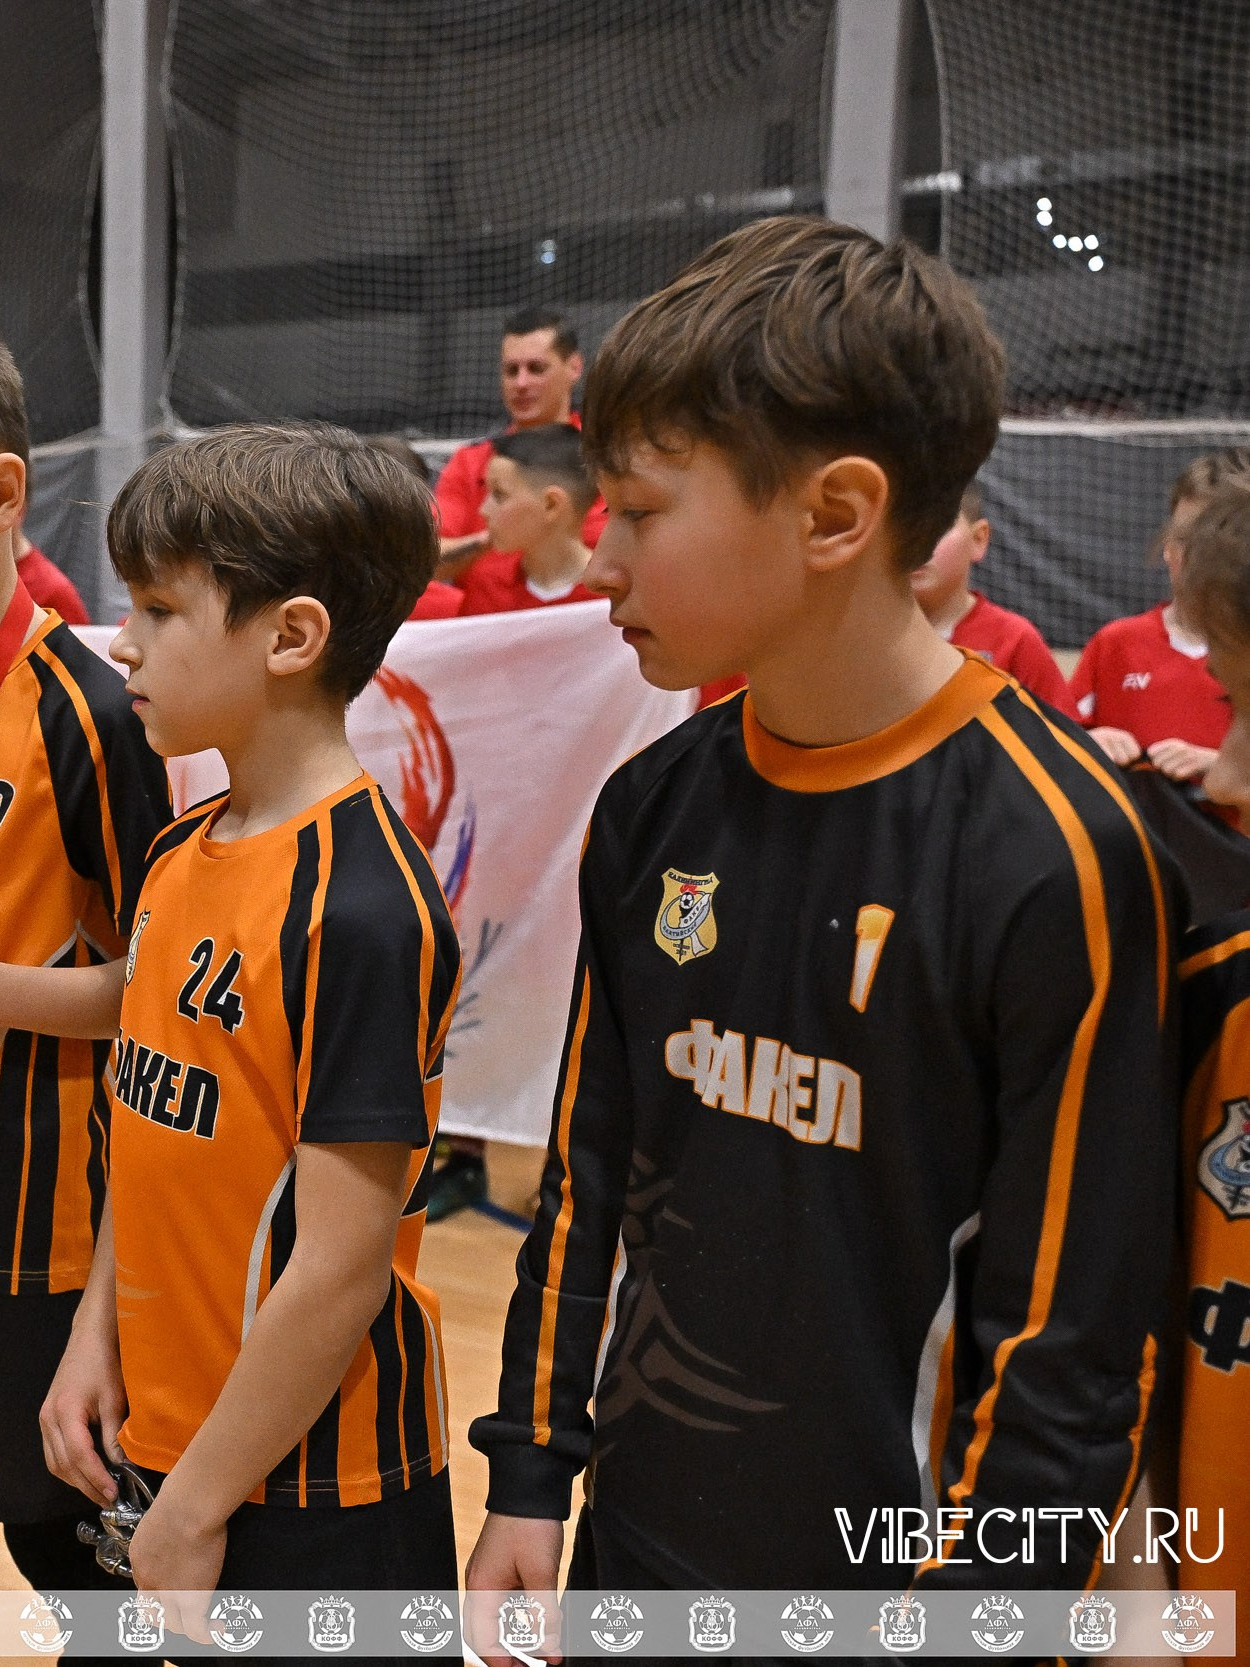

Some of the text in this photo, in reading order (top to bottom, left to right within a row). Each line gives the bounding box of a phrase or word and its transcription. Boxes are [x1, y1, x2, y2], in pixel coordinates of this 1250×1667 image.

[176, 936, 245, 1036] 24
[849, 903, 895, 1013] 1
[664, 1018, 863, 1152] ФАКЕЛ
